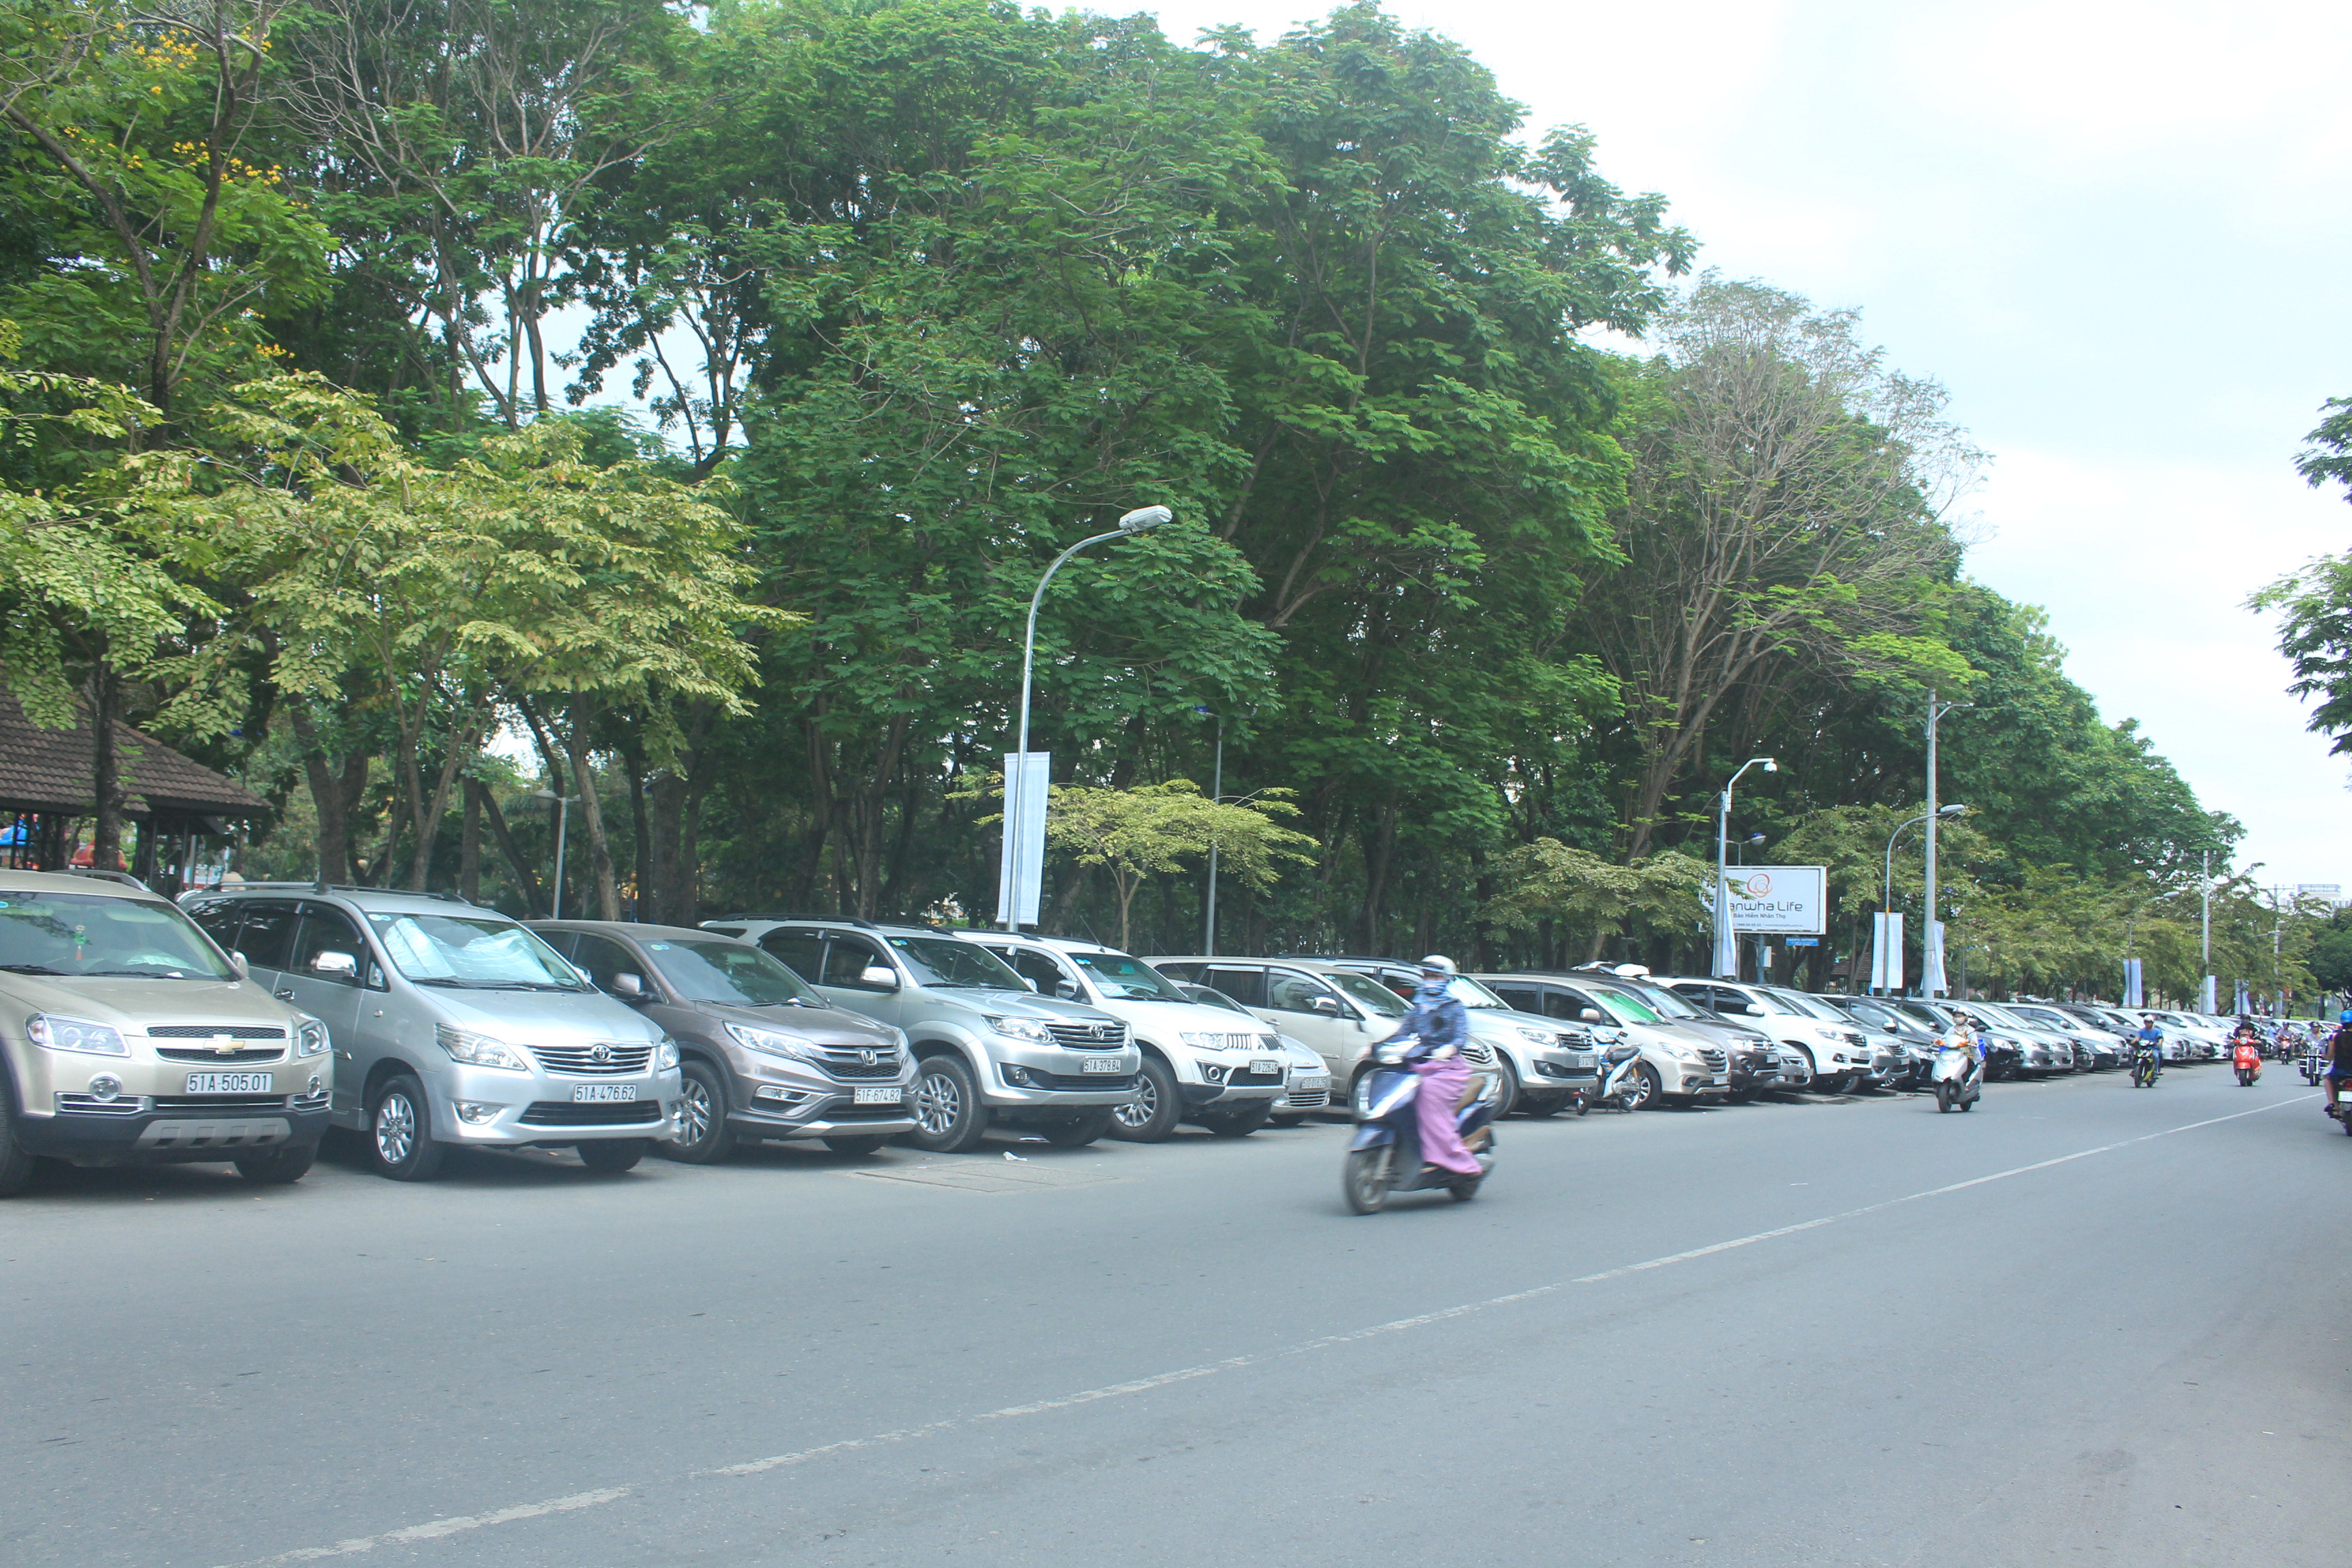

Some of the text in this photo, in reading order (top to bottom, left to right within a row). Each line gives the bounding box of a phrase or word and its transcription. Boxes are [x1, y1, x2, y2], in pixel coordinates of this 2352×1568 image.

[1729, 901, 1802, 911] anwha Life
[1084, 1060, 1120, 1071] 51A-378.84
[189, 1075, 267, 1091] 51A-505.01
[576, 1086, 634, 1100] 51A-476.62
[855, 1090, 900, 1101] 51F-674.82
